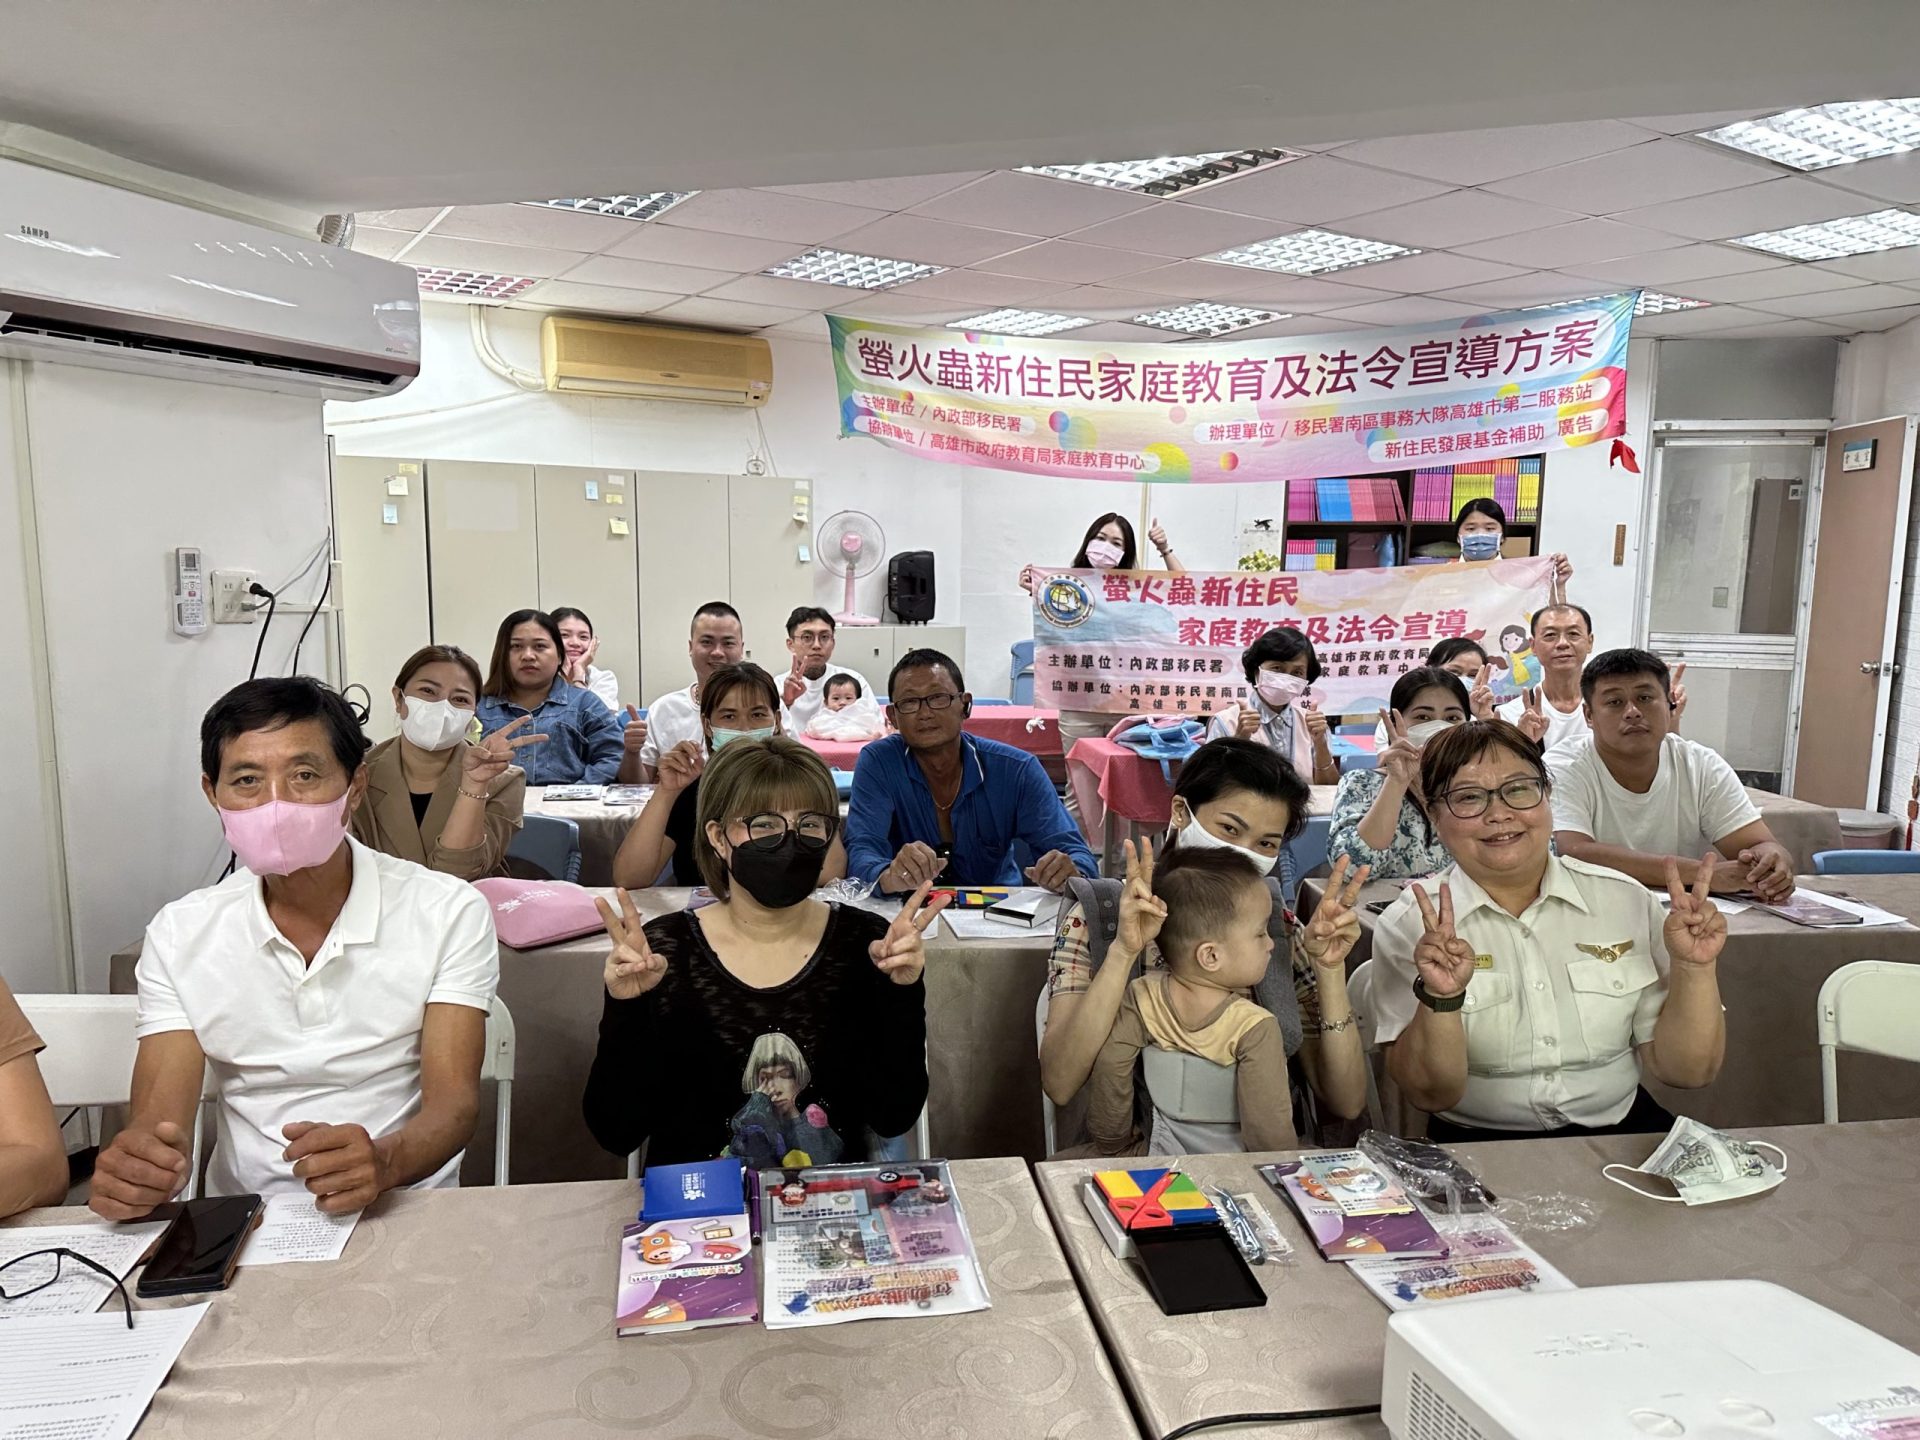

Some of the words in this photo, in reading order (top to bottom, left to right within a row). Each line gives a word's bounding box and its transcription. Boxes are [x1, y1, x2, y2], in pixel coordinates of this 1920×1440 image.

[20, 225, 49, 239] SAMPO
[858, 318, 1599, 405] 螢火蟲新住民家庭教育及法令宣導方案
[932, 406, 1022, 432] 內政部移民署
[1208, 423, 1275, 442] 辦理單位
[1294, 382, 1593, 437] 移民署南區事務大隊高雄市第二服務站
[930, 434, 1146, 470] 高雄市政府教育局家庭教育中心
[1384, 423, 1545, 459] 新住民發展基金補助
[1557, 414, 1594, 437] 廣告
[1102, 574, 1298, 606] 螢火蟲新住民
[1178, 609, 1468, 647] 家庭教及法令宣導
[1320, 663, 1409, 678] 家庭教育中
